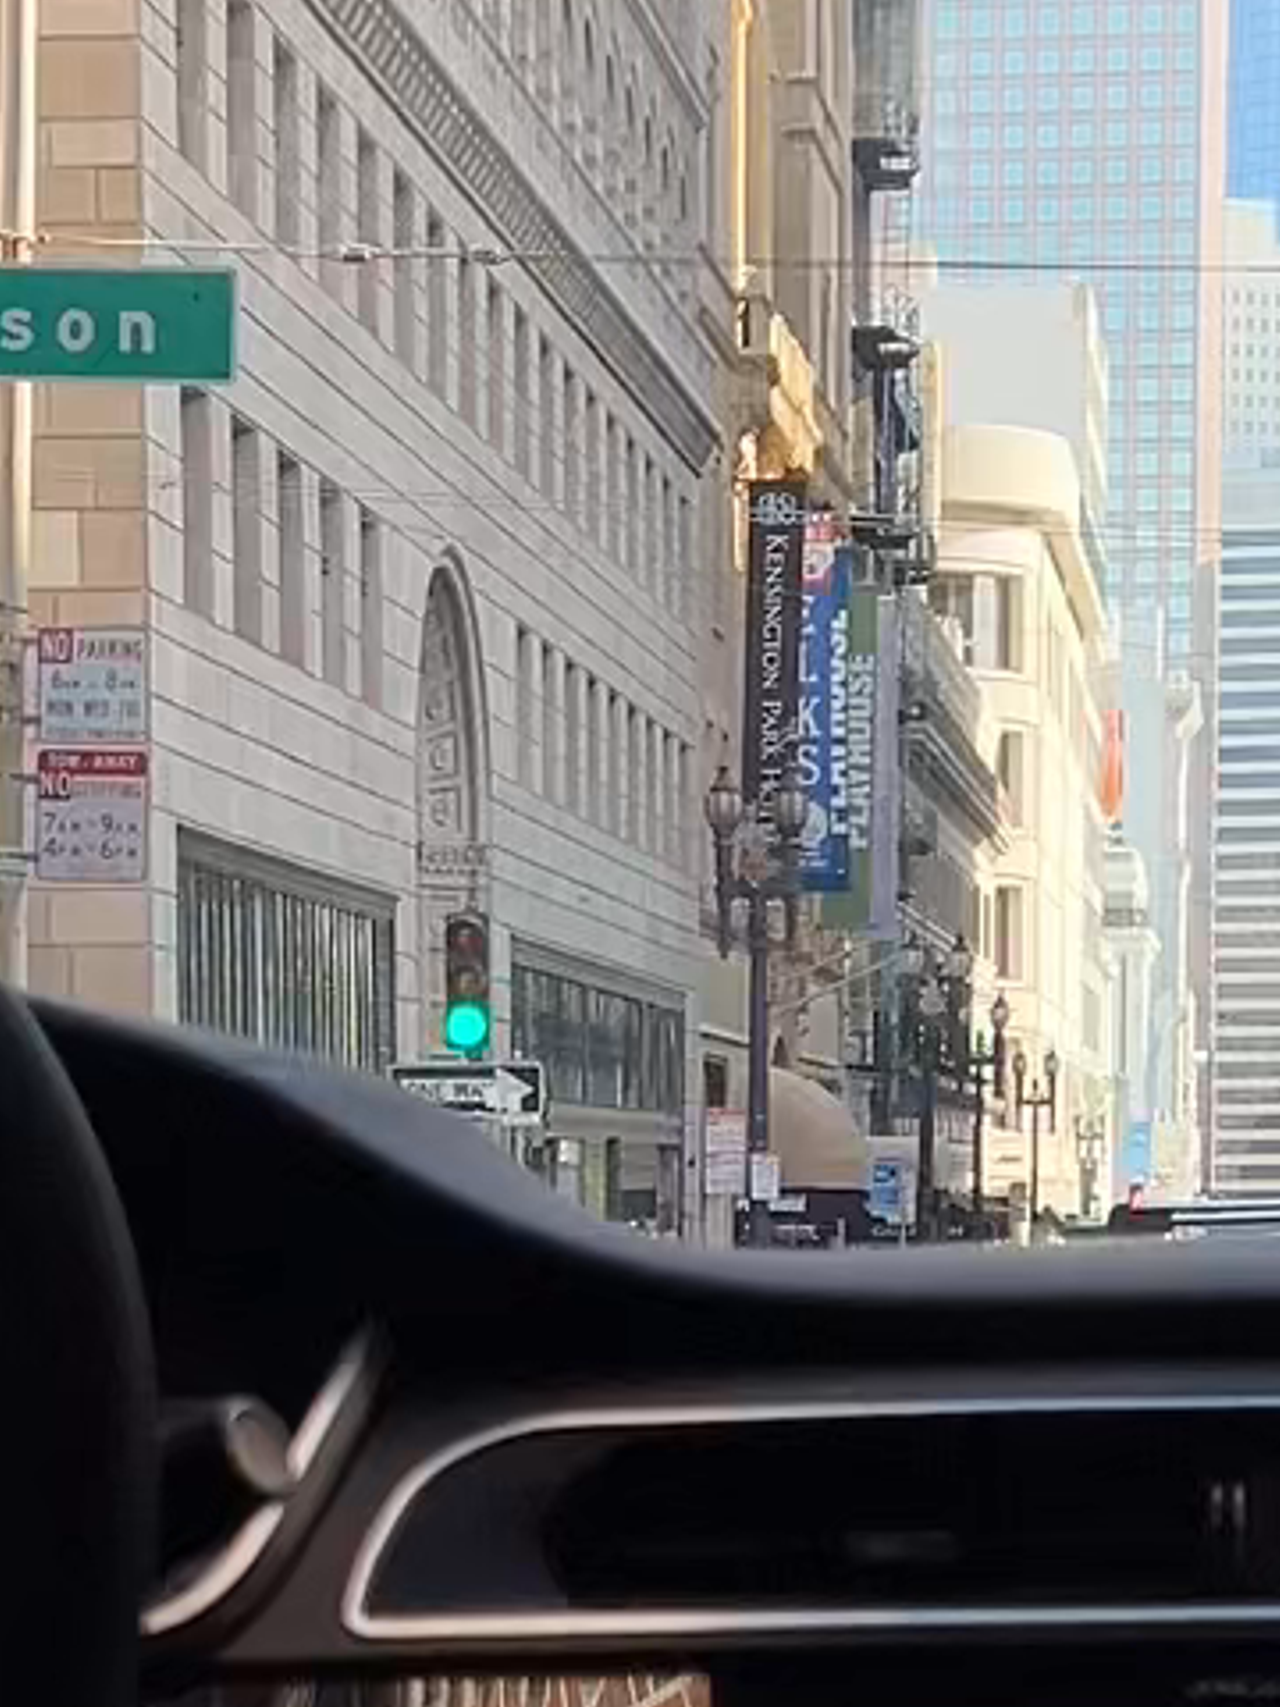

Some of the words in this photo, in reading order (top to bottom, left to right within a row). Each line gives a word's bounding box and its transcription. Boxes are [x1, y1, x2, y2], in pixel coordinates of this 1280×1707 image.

[41, 633, 72, 661] NO
[762, 533, 790, 689] KENSINGTON
[41, 770, 71, 796] NO
[848, 653, 874, 849] PLAYHOUSE
